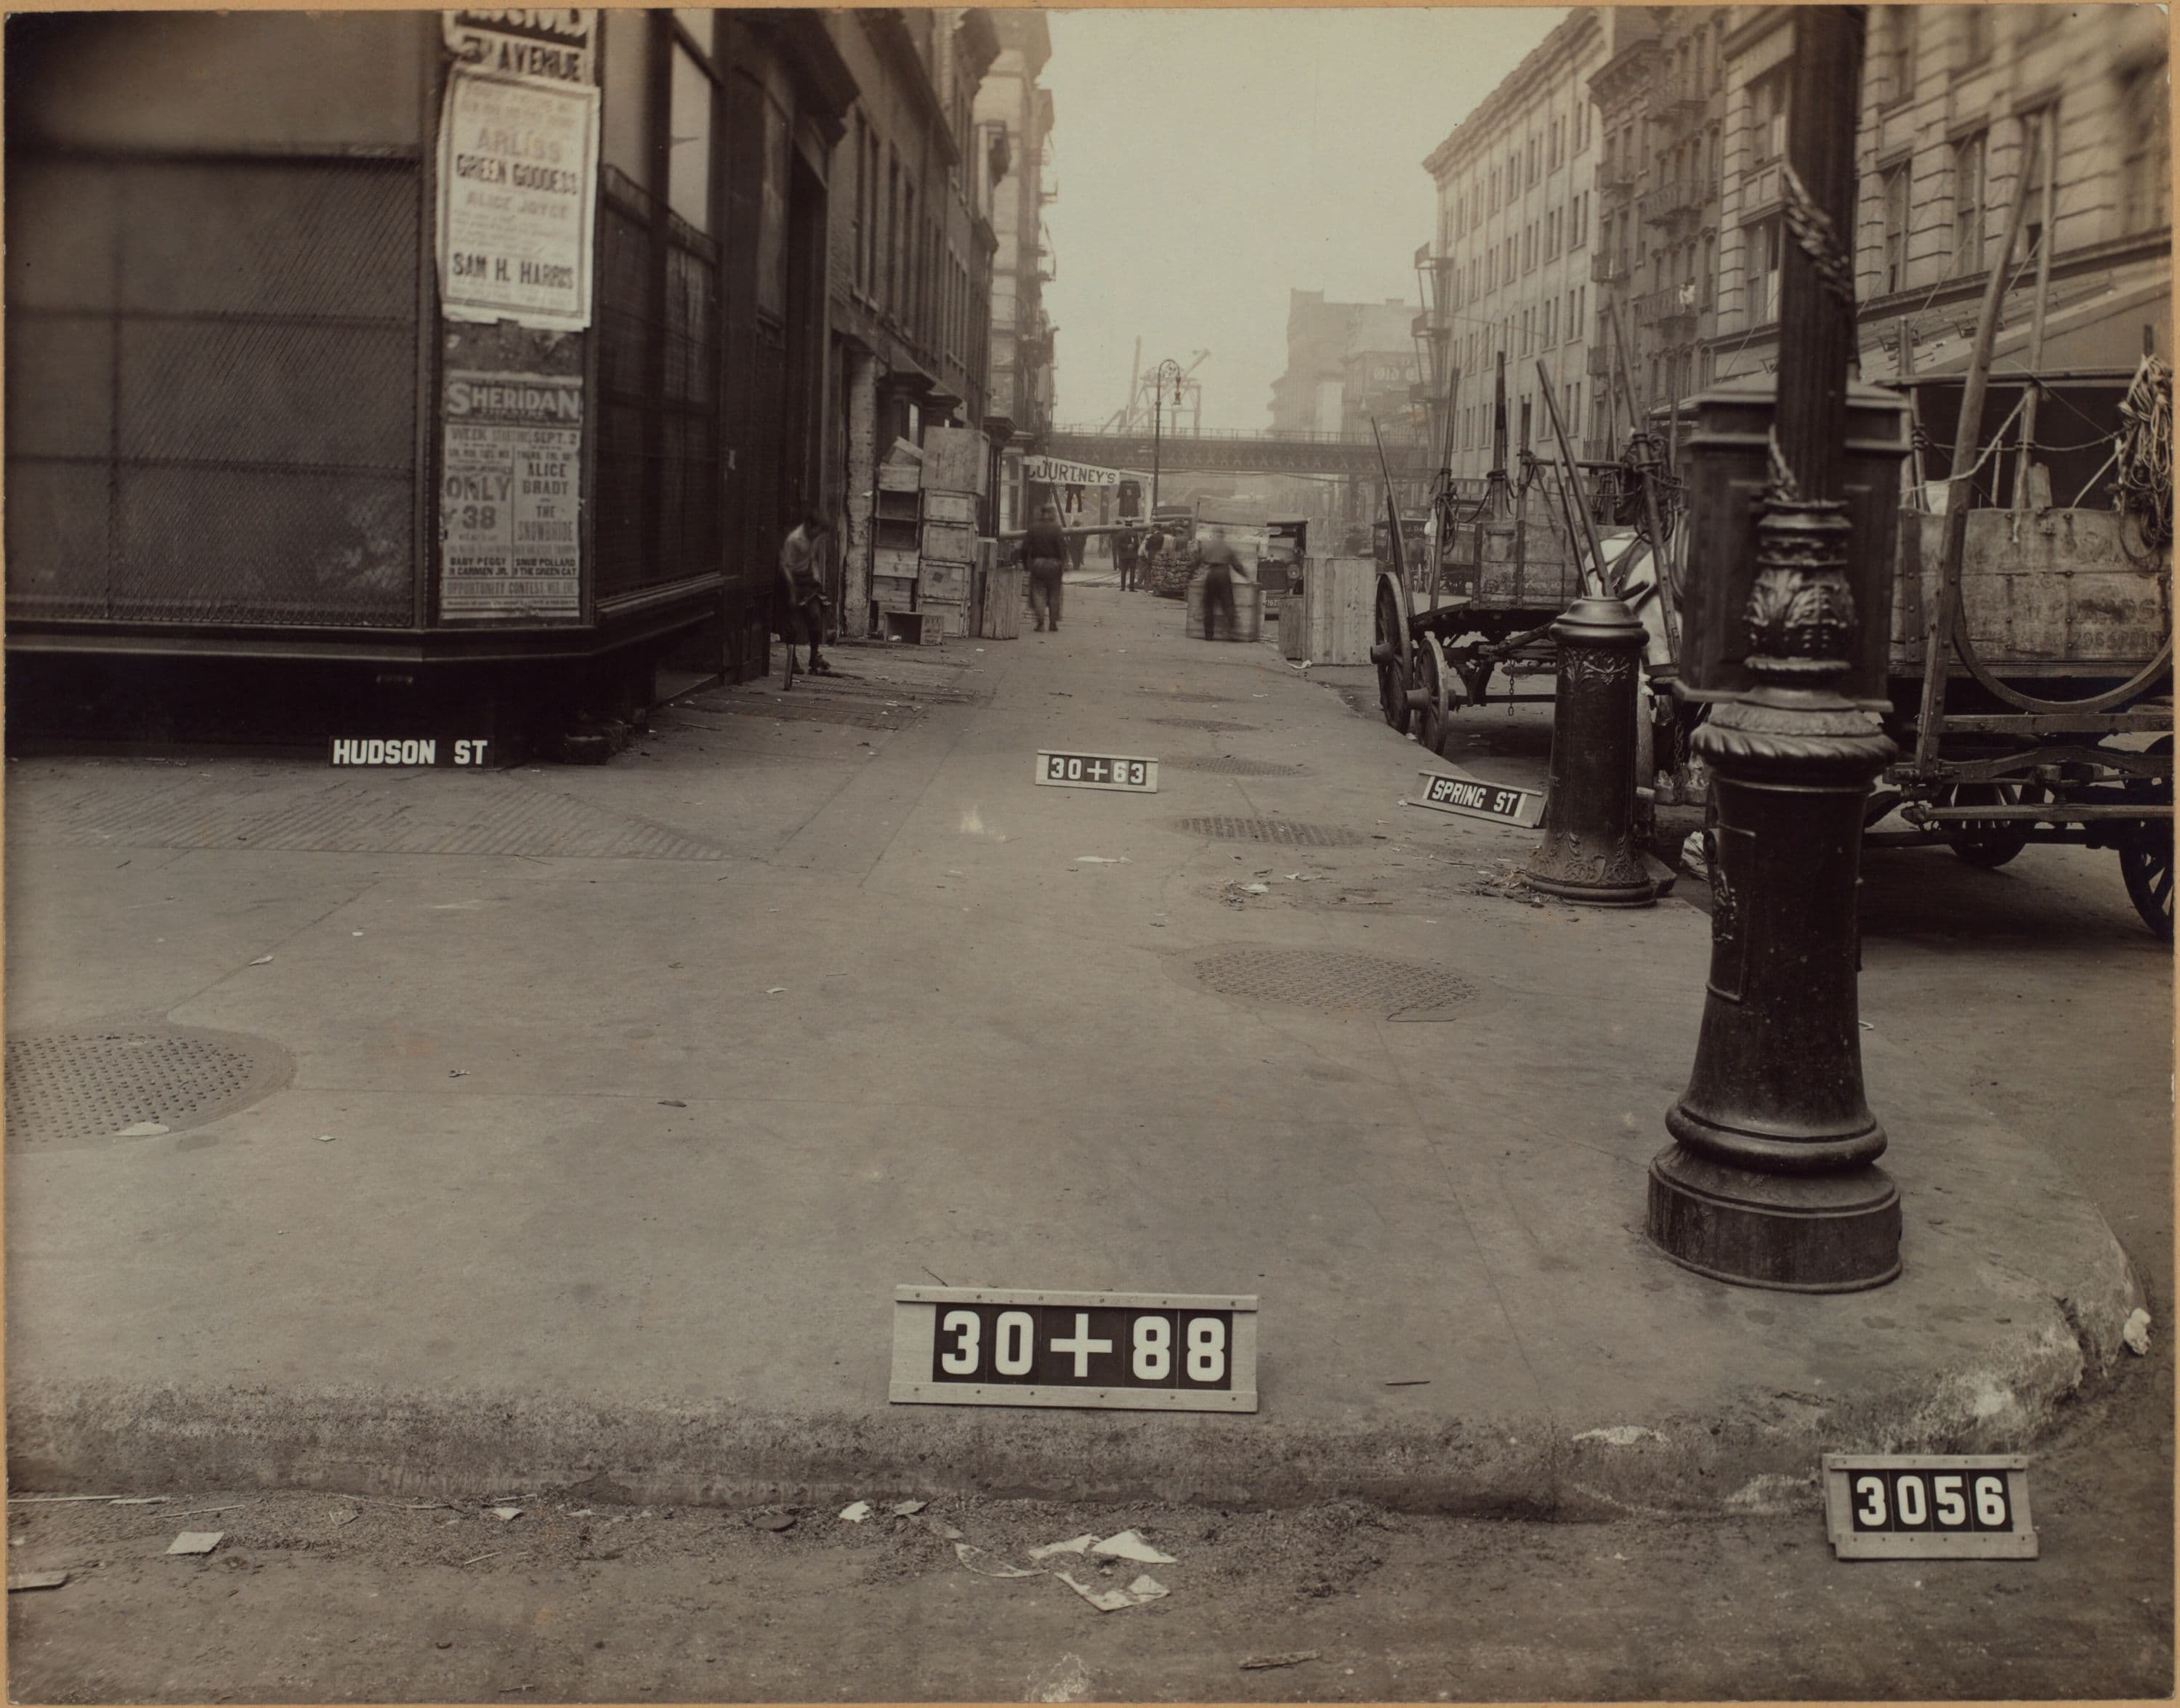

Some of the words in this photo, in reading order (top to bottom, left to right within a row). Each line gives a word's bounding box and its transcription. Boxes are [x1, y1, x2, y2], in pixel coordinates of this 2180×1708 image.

[453, 252, 488, 279] SAM
[447, 382, 580, 419] SHERIDAN
[527, 463, 567, 477] ALICE
[446, 476, 510, 501] ONLY
[462, 506, 496, 530] 38
[536, 506, 556, 518] THE
[450, 557, 475, 566] BABY
[477, 557, 507, 566] PEGGY
[333, 739, 436, 764] HUDSON
[454, 739, 488, 764] ST
[1050, 757, 1145, 784] 30+63
[1432, 780, 1487, 808] SPRING
[1493, 791, 1518, 814] ST
[942, 1310, 1225, 1382] 30+88
[1857, 1476, 2006, 1526] 3056
